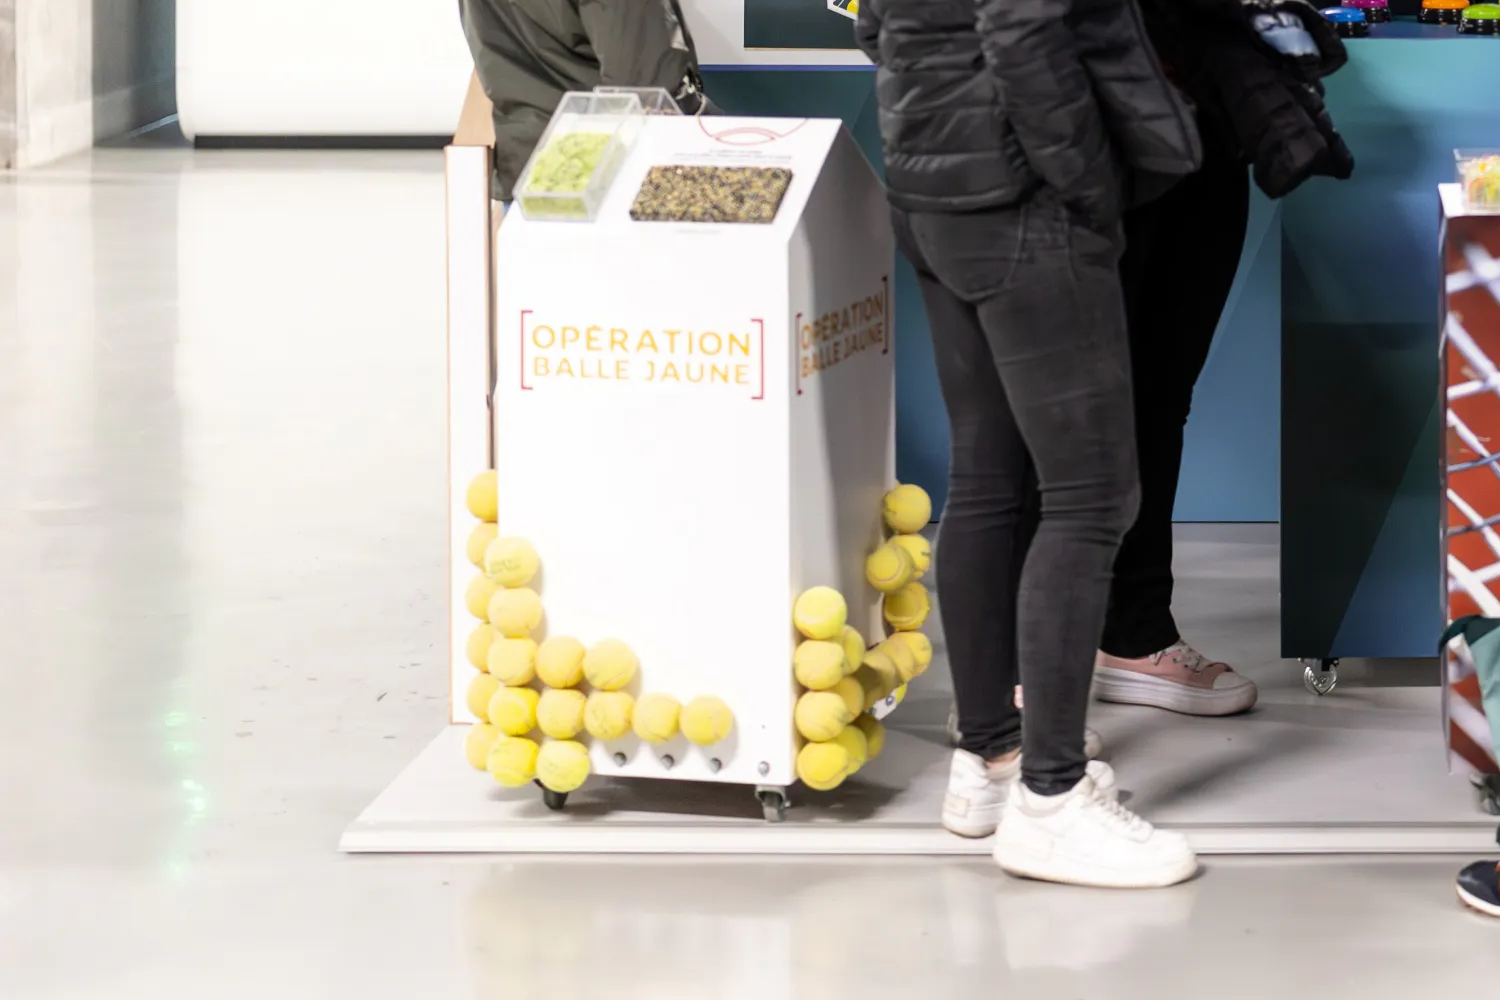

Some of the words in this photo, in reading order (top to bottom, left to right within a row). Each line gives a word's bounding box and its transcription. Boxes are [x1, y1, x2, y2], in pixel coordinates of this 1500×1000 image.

[532, 324, 751, 357] OPÉRATION
[533, 356, 629, 380] BALLE
[644, 361, 750, 385] JAUNE
